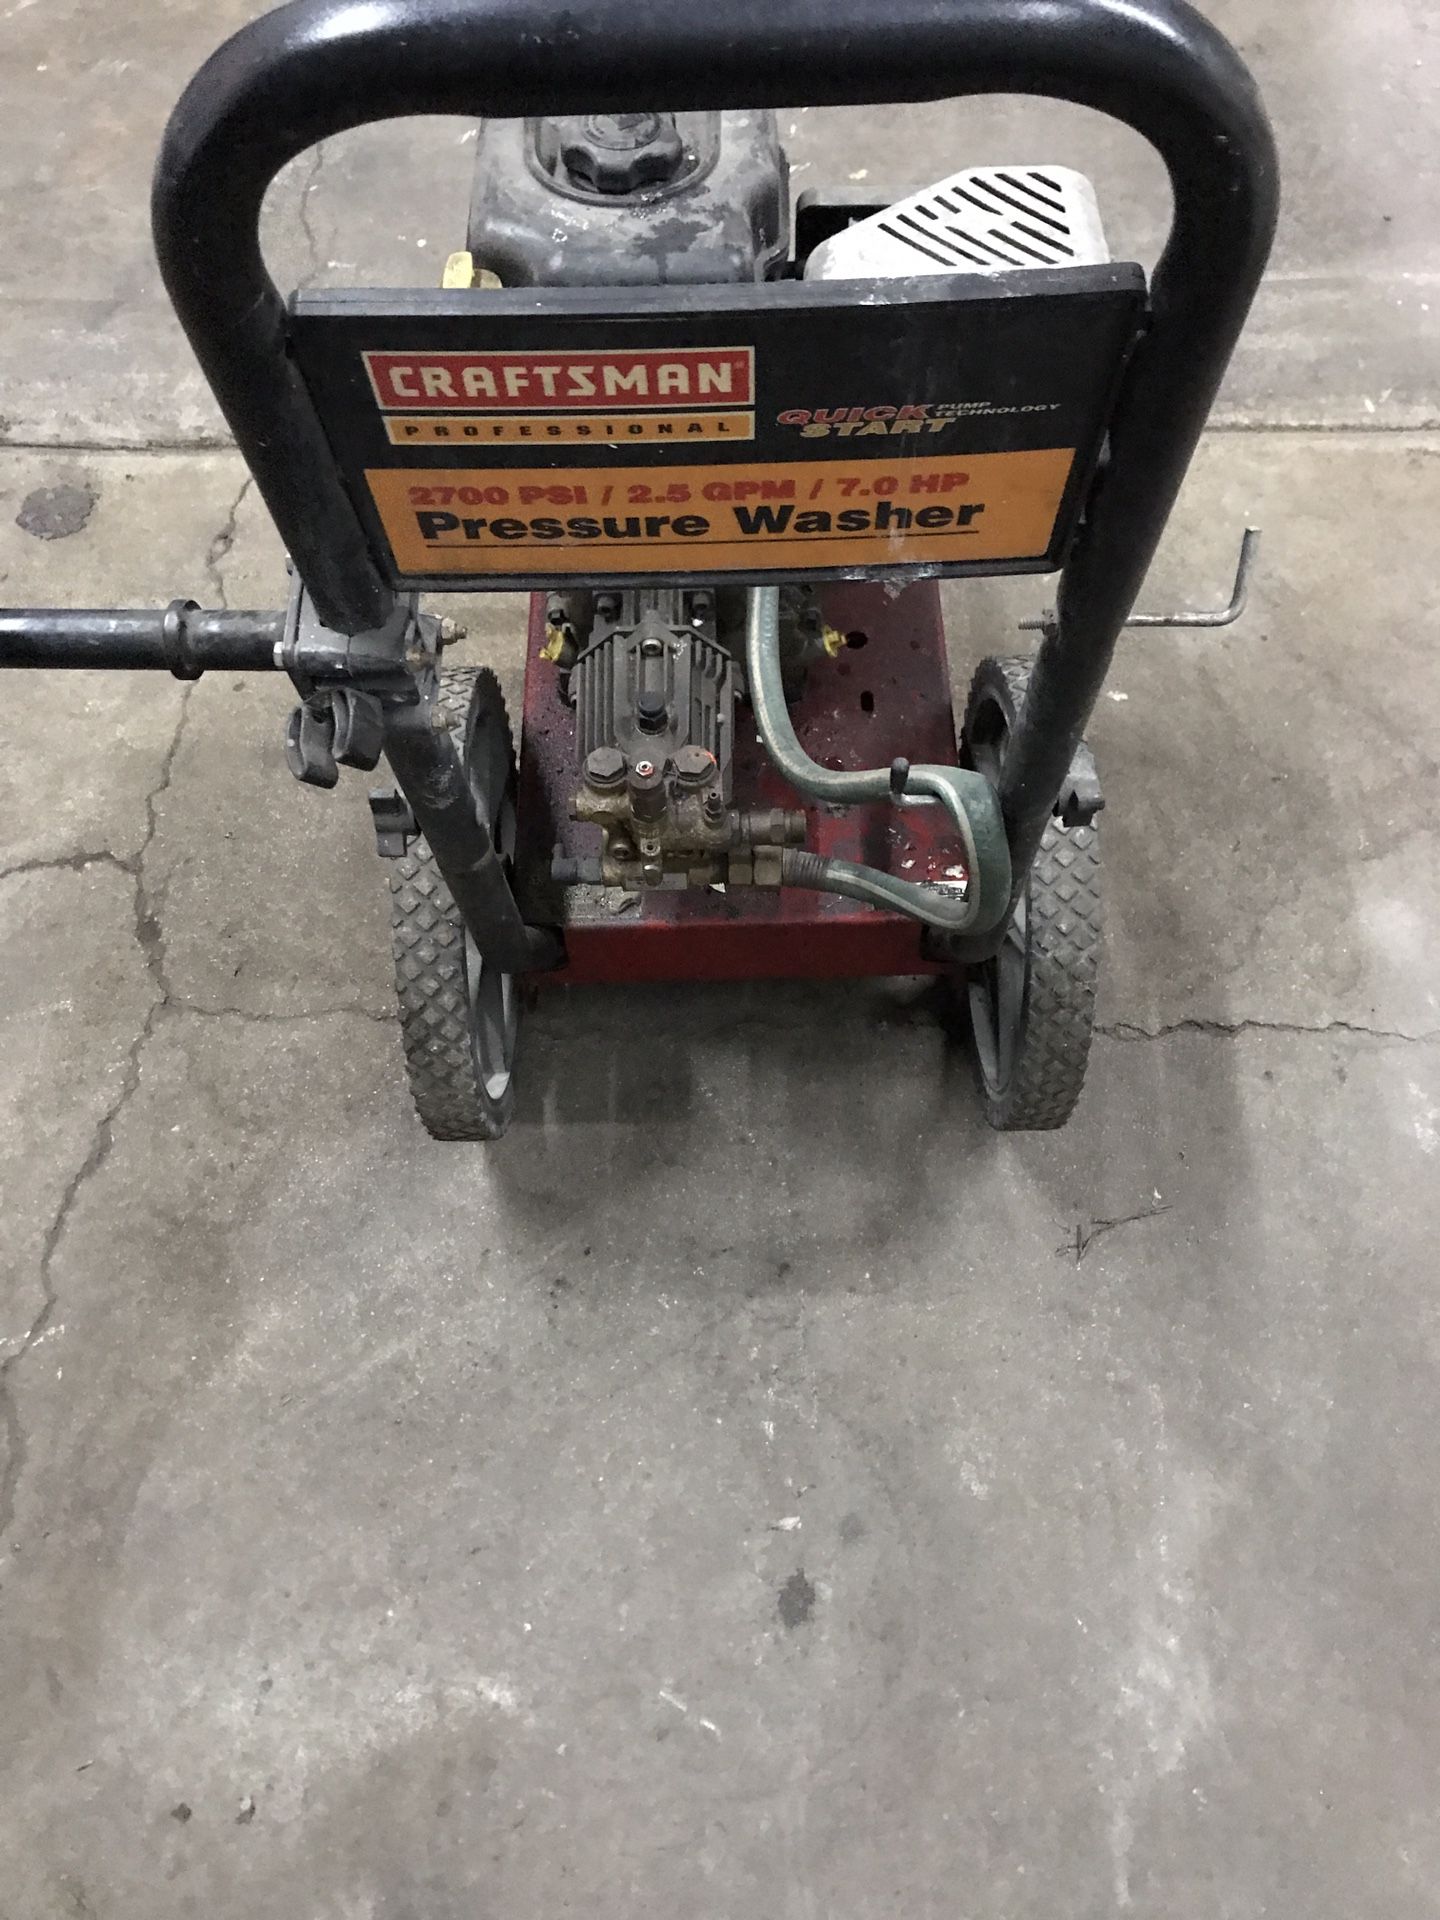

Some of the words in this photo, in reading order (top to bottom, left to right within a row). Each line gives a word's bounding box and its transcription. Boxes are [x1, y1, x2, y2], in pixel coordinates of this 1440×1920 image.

[388, 362, 733, 398] CRAFTSMAN
[777, 404, 934, 425] QUICK
[934, 403, 1061, 417] TECHNOLOGY
[937, 401, 991, 411] PUMP
[405, 421, 730, 437] PROFESSIONAL
[800, 417, 957, 438] START
[408, 485, 511, 506] 2700
[518, 484, 588, 506] PSI
[601, 485, 615, 507] /
[628, 482, 693, 504] 2.5
[701, 478, 796, 503] GPM
[809, 478, 825, 500] /
[836, 475, 899, 497] 7.0
[909, 471, 971, 495] HP
[415, 510, 711, 540] Pressure
[733, 501, 985, 535] Washer
